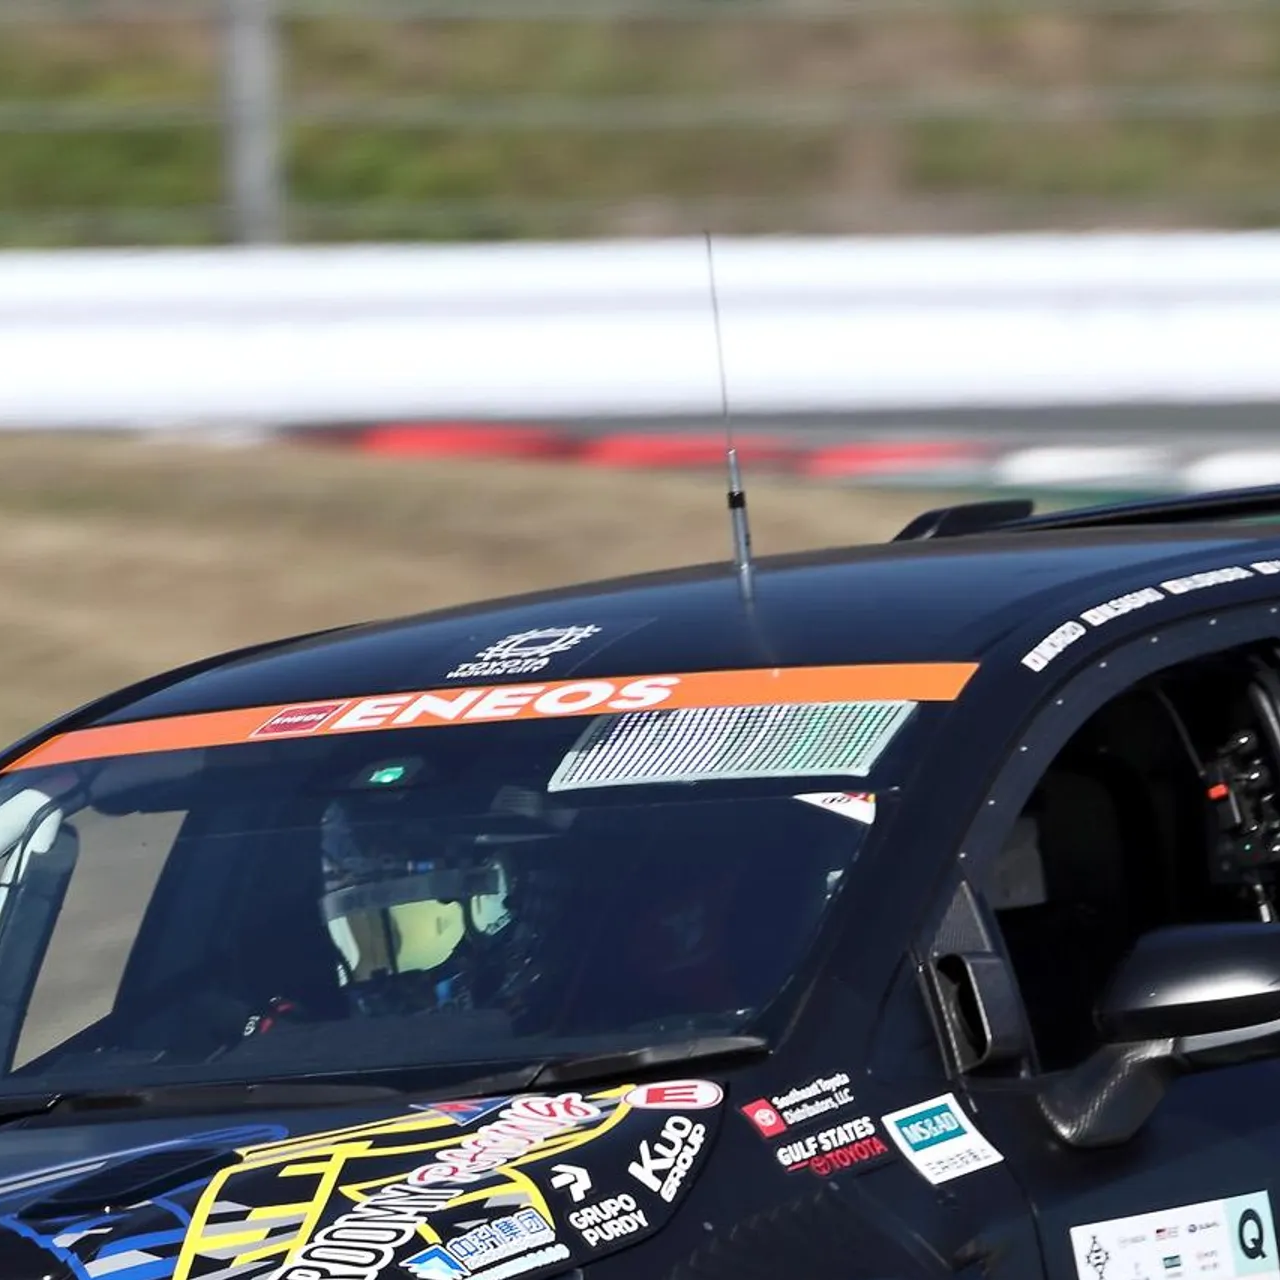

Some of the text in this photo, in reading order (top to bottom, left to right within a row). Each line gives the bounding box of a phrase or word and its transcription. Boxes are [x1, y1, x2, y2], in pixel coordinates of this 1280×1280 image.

[271, 712, 324, 727] ENEOS
[331, 676, 681, 730] ENEOS
[776, 1116, 876, 1165] GULF STATES
[901, 1111, 960, 1145] MS&AD
[660, 1123, 706, 1203] GROUP
[826, 1136, 889, 1170] TOYOTA
[568, 1193, 637, 1231] GRUPO
[581, 1209, 649, 1247] PURDY
[1237, 1207, 1267, 1261] Q
